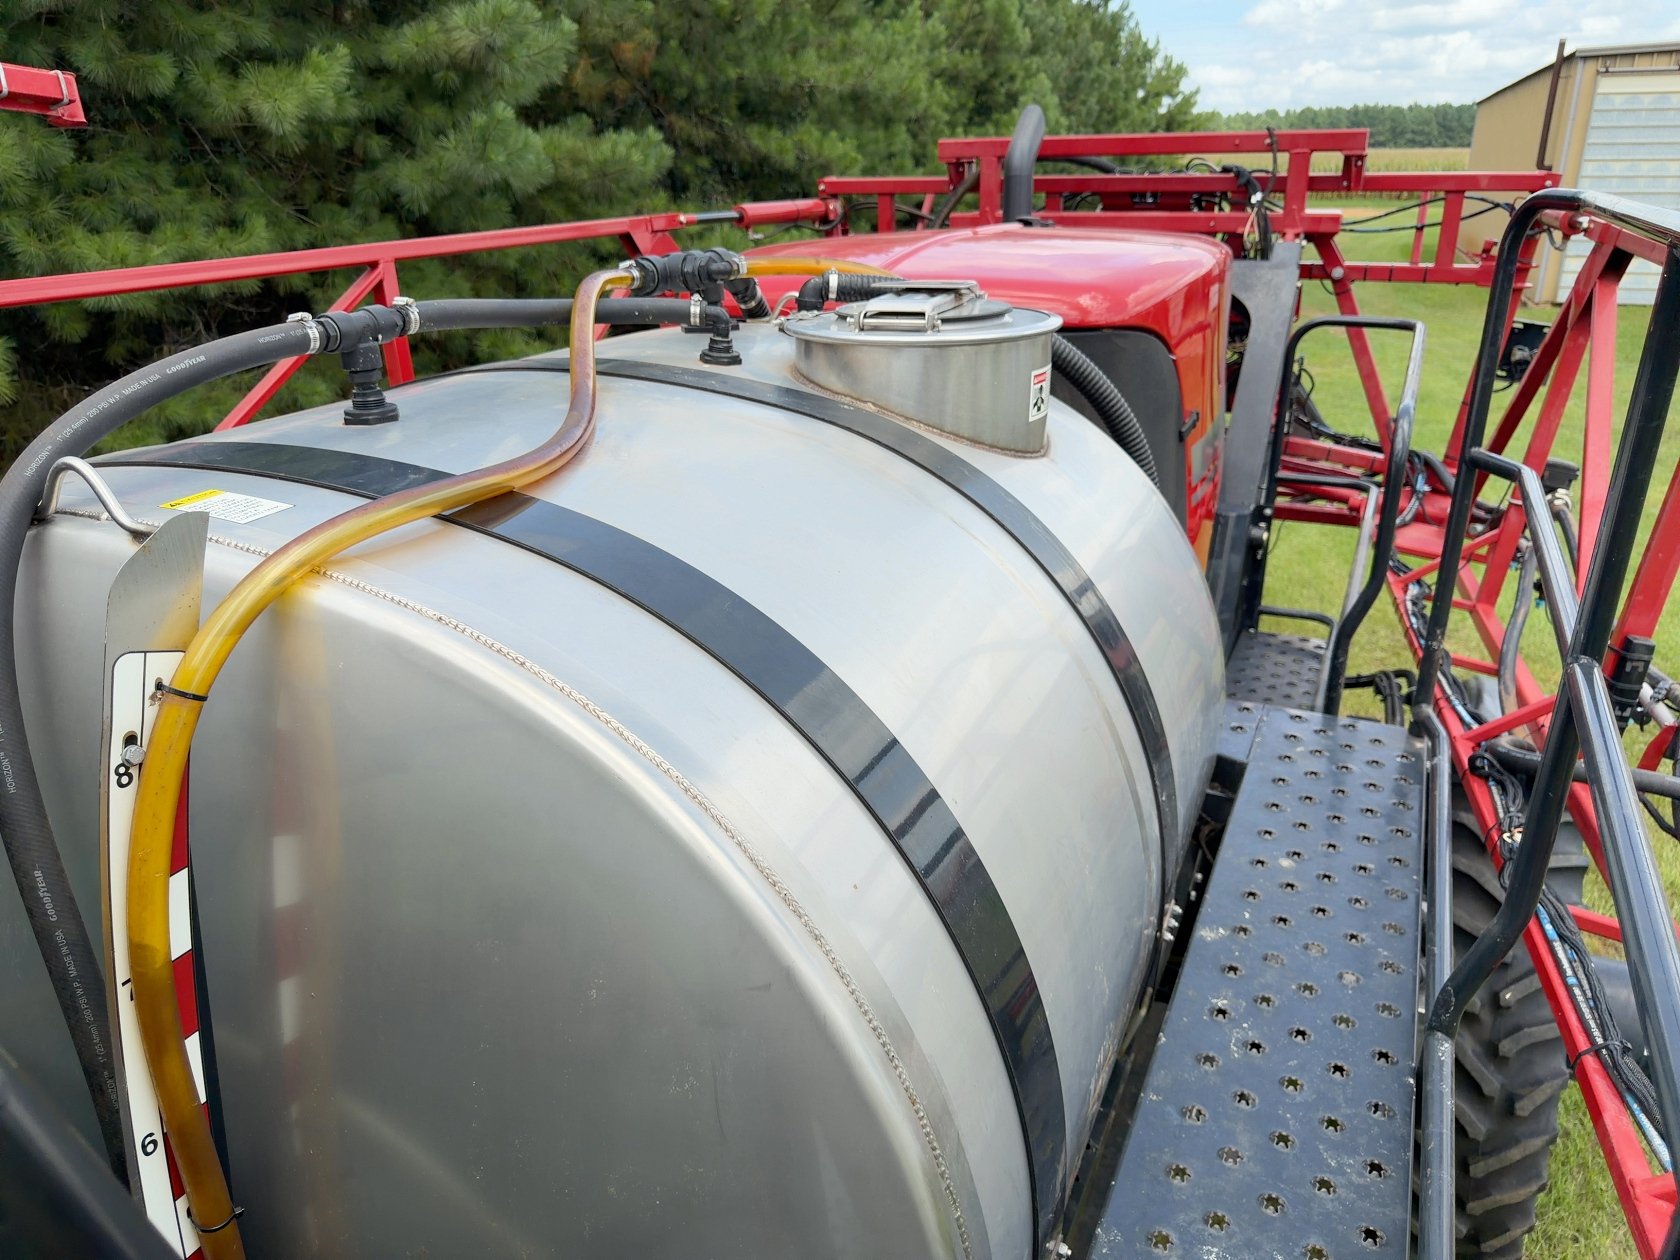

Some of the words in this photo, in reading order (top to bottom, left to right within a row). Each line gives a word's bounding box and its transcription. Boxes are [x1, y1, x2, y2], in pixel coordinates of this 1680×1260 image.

[122, 382, 142, 396] MADE
[139, 378, 150, 389] IN
[148, 372, 163, 384] USA
[166, 355, 207, 374] GOODYEAR
[114, 762, 134, 789] 8
[34, 869, 59, 922] GOODYEAR
[55, 928, 67, 947] USA
[60, 945, 70, 955] IN
[64, 954, 78, 978] MADE
[141, 1132, 159, 1157] 6
